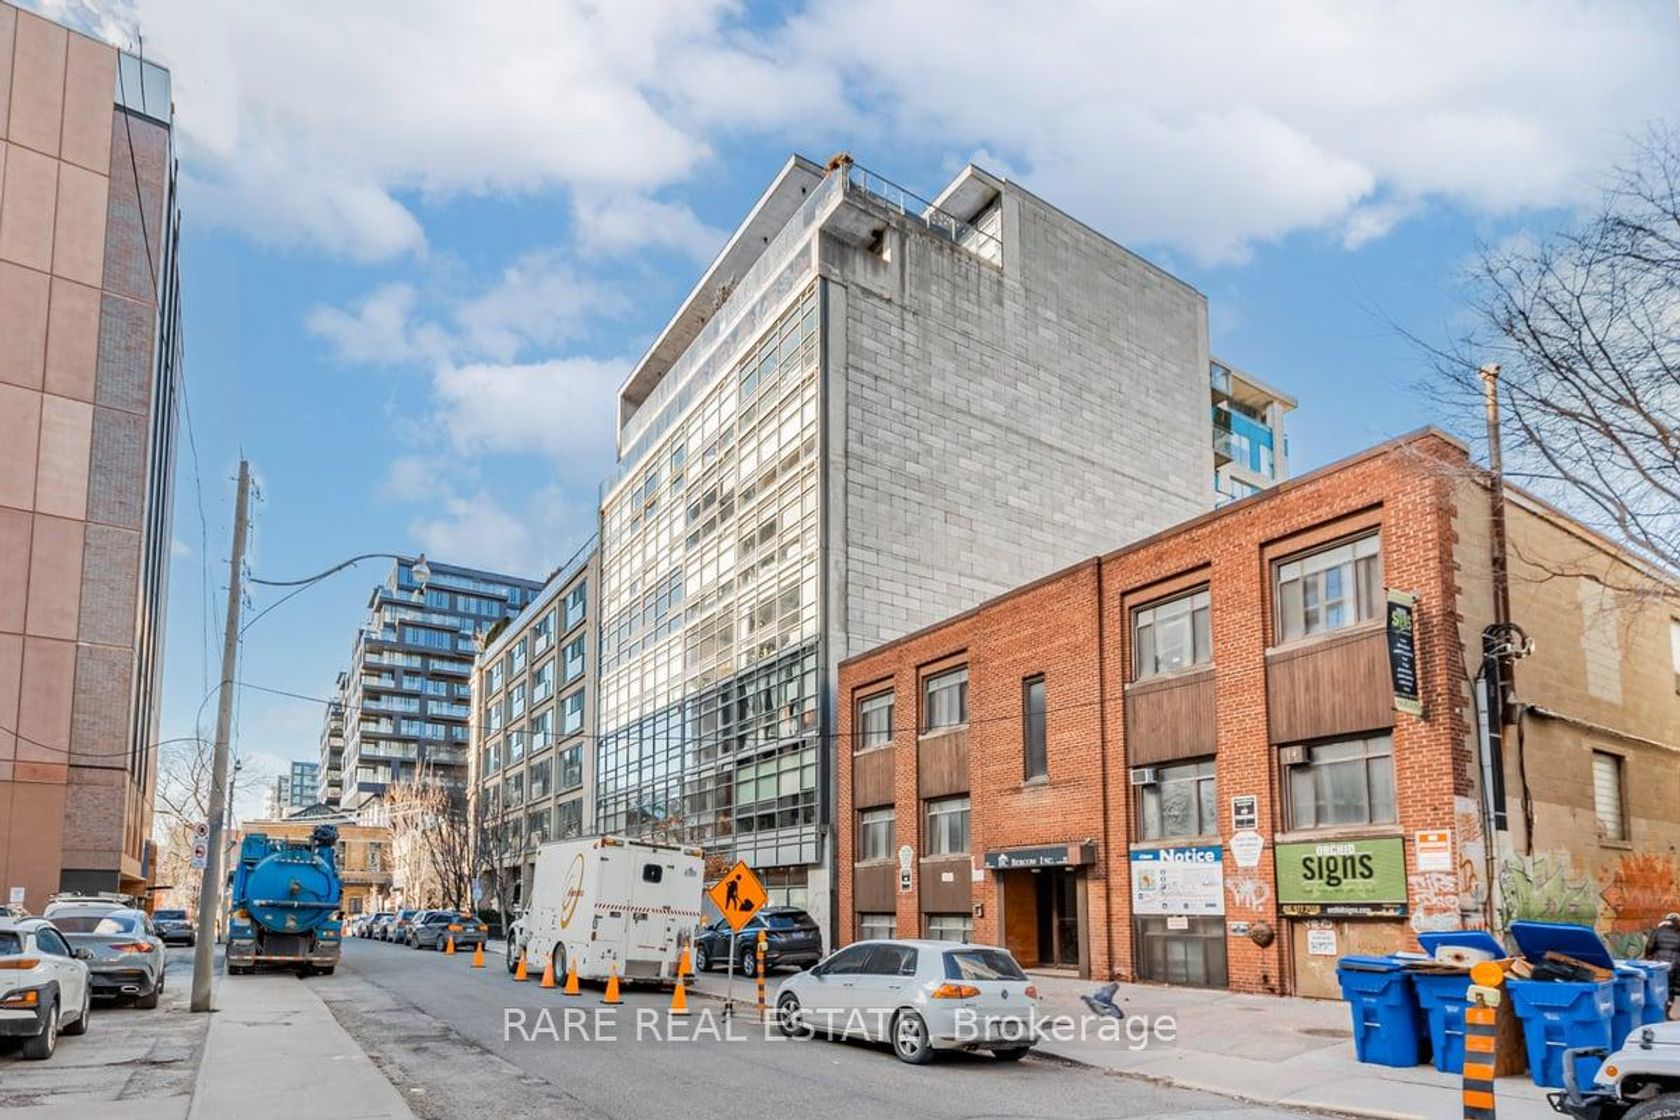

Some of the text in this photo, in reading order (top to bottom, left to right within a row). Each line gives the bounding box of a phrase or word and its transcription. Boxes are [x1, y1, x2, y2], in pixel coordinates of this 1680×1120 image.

[1159, 848, 1215, 863] Notice
[1316, 844, 1356, 856] ORCHID
[1302, 854, 1374, 887] signs
